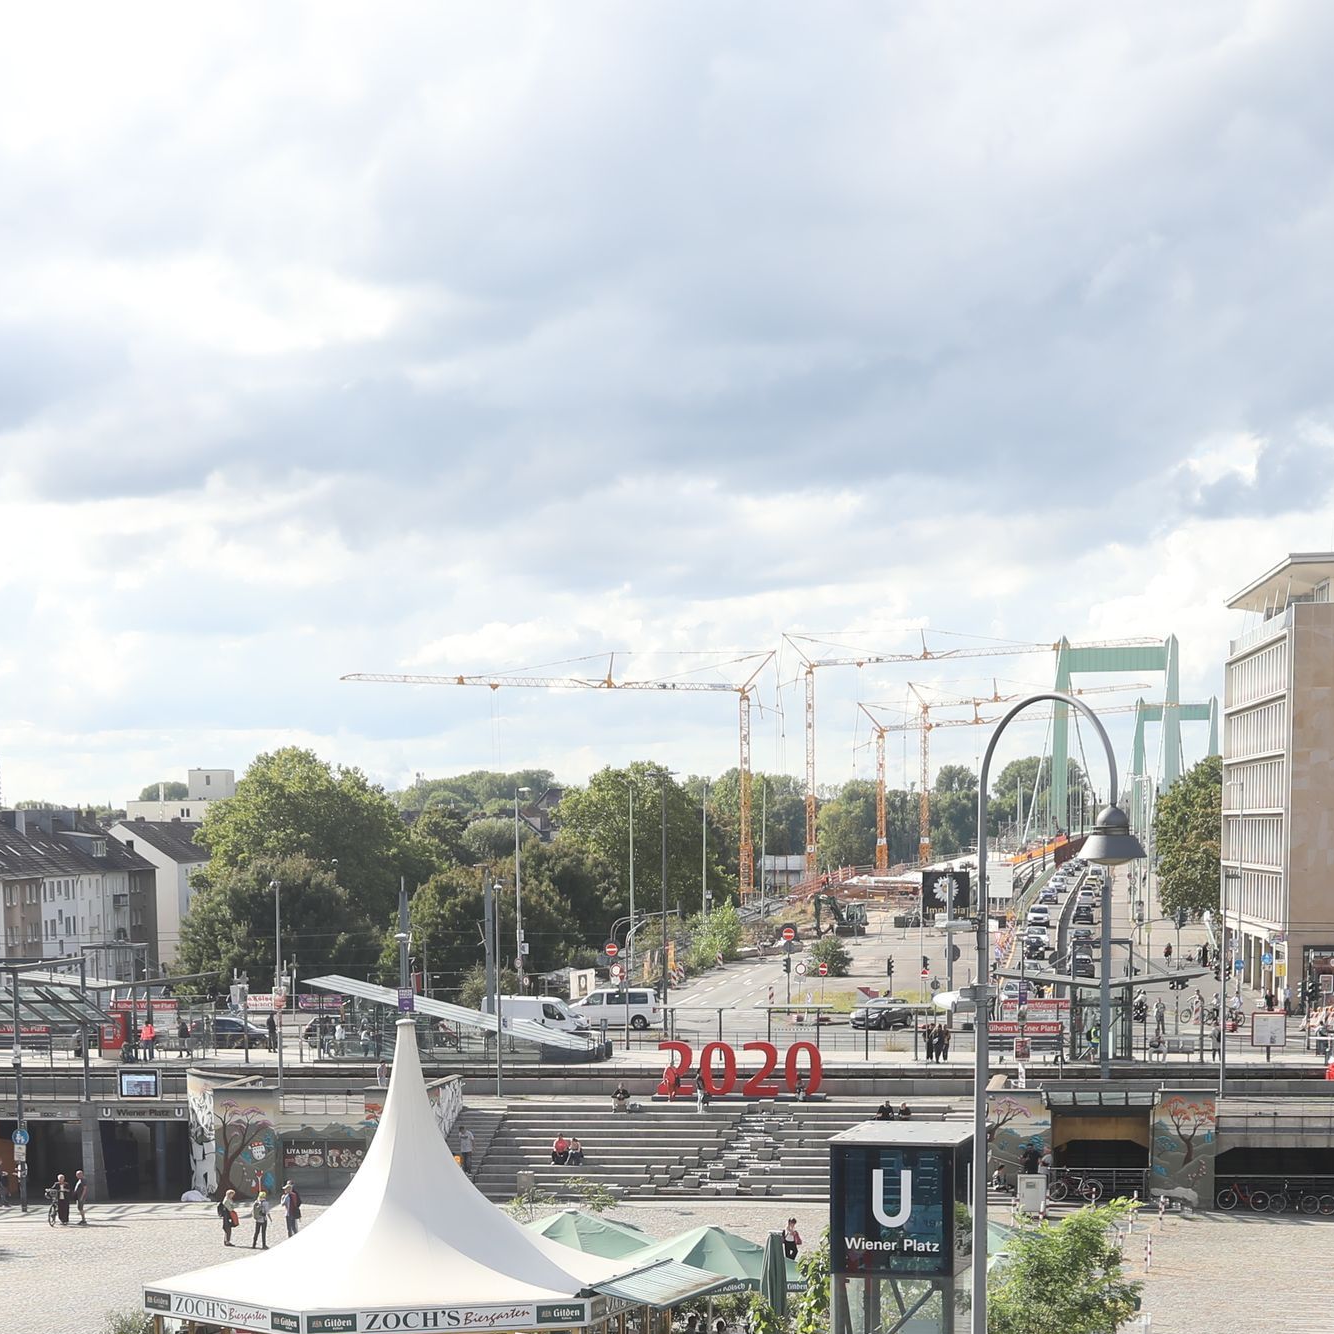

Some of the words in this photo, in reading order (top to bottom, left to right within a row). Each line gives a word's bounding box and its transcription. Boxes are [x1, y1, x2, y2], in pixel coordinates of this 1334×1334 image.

[657, 1041, 823, 1098] 2020
[102, 1107, 111, 1117] U
[117, 1108, 147, 1117] Wiener
[149, 1108, 169, 1117] Platz
[174, 1108, 183, 1117] U
[872, 1169, 912, 1228] U
[844, 1237, 897, 1251] Wiener
[903, 1239, 940, 1252] Platz
[175, 1296, 227, 1320] ZOCH'S
[228, 1307, 267, 1325] Biergarten
[365, 1310, 461, 1330] ZOCH'S
[464, 1307, 530, 1327] Biergarten
[553, 1308, 580, 1318] Gilden
[324, 1318, 352, 1328] Gilden
